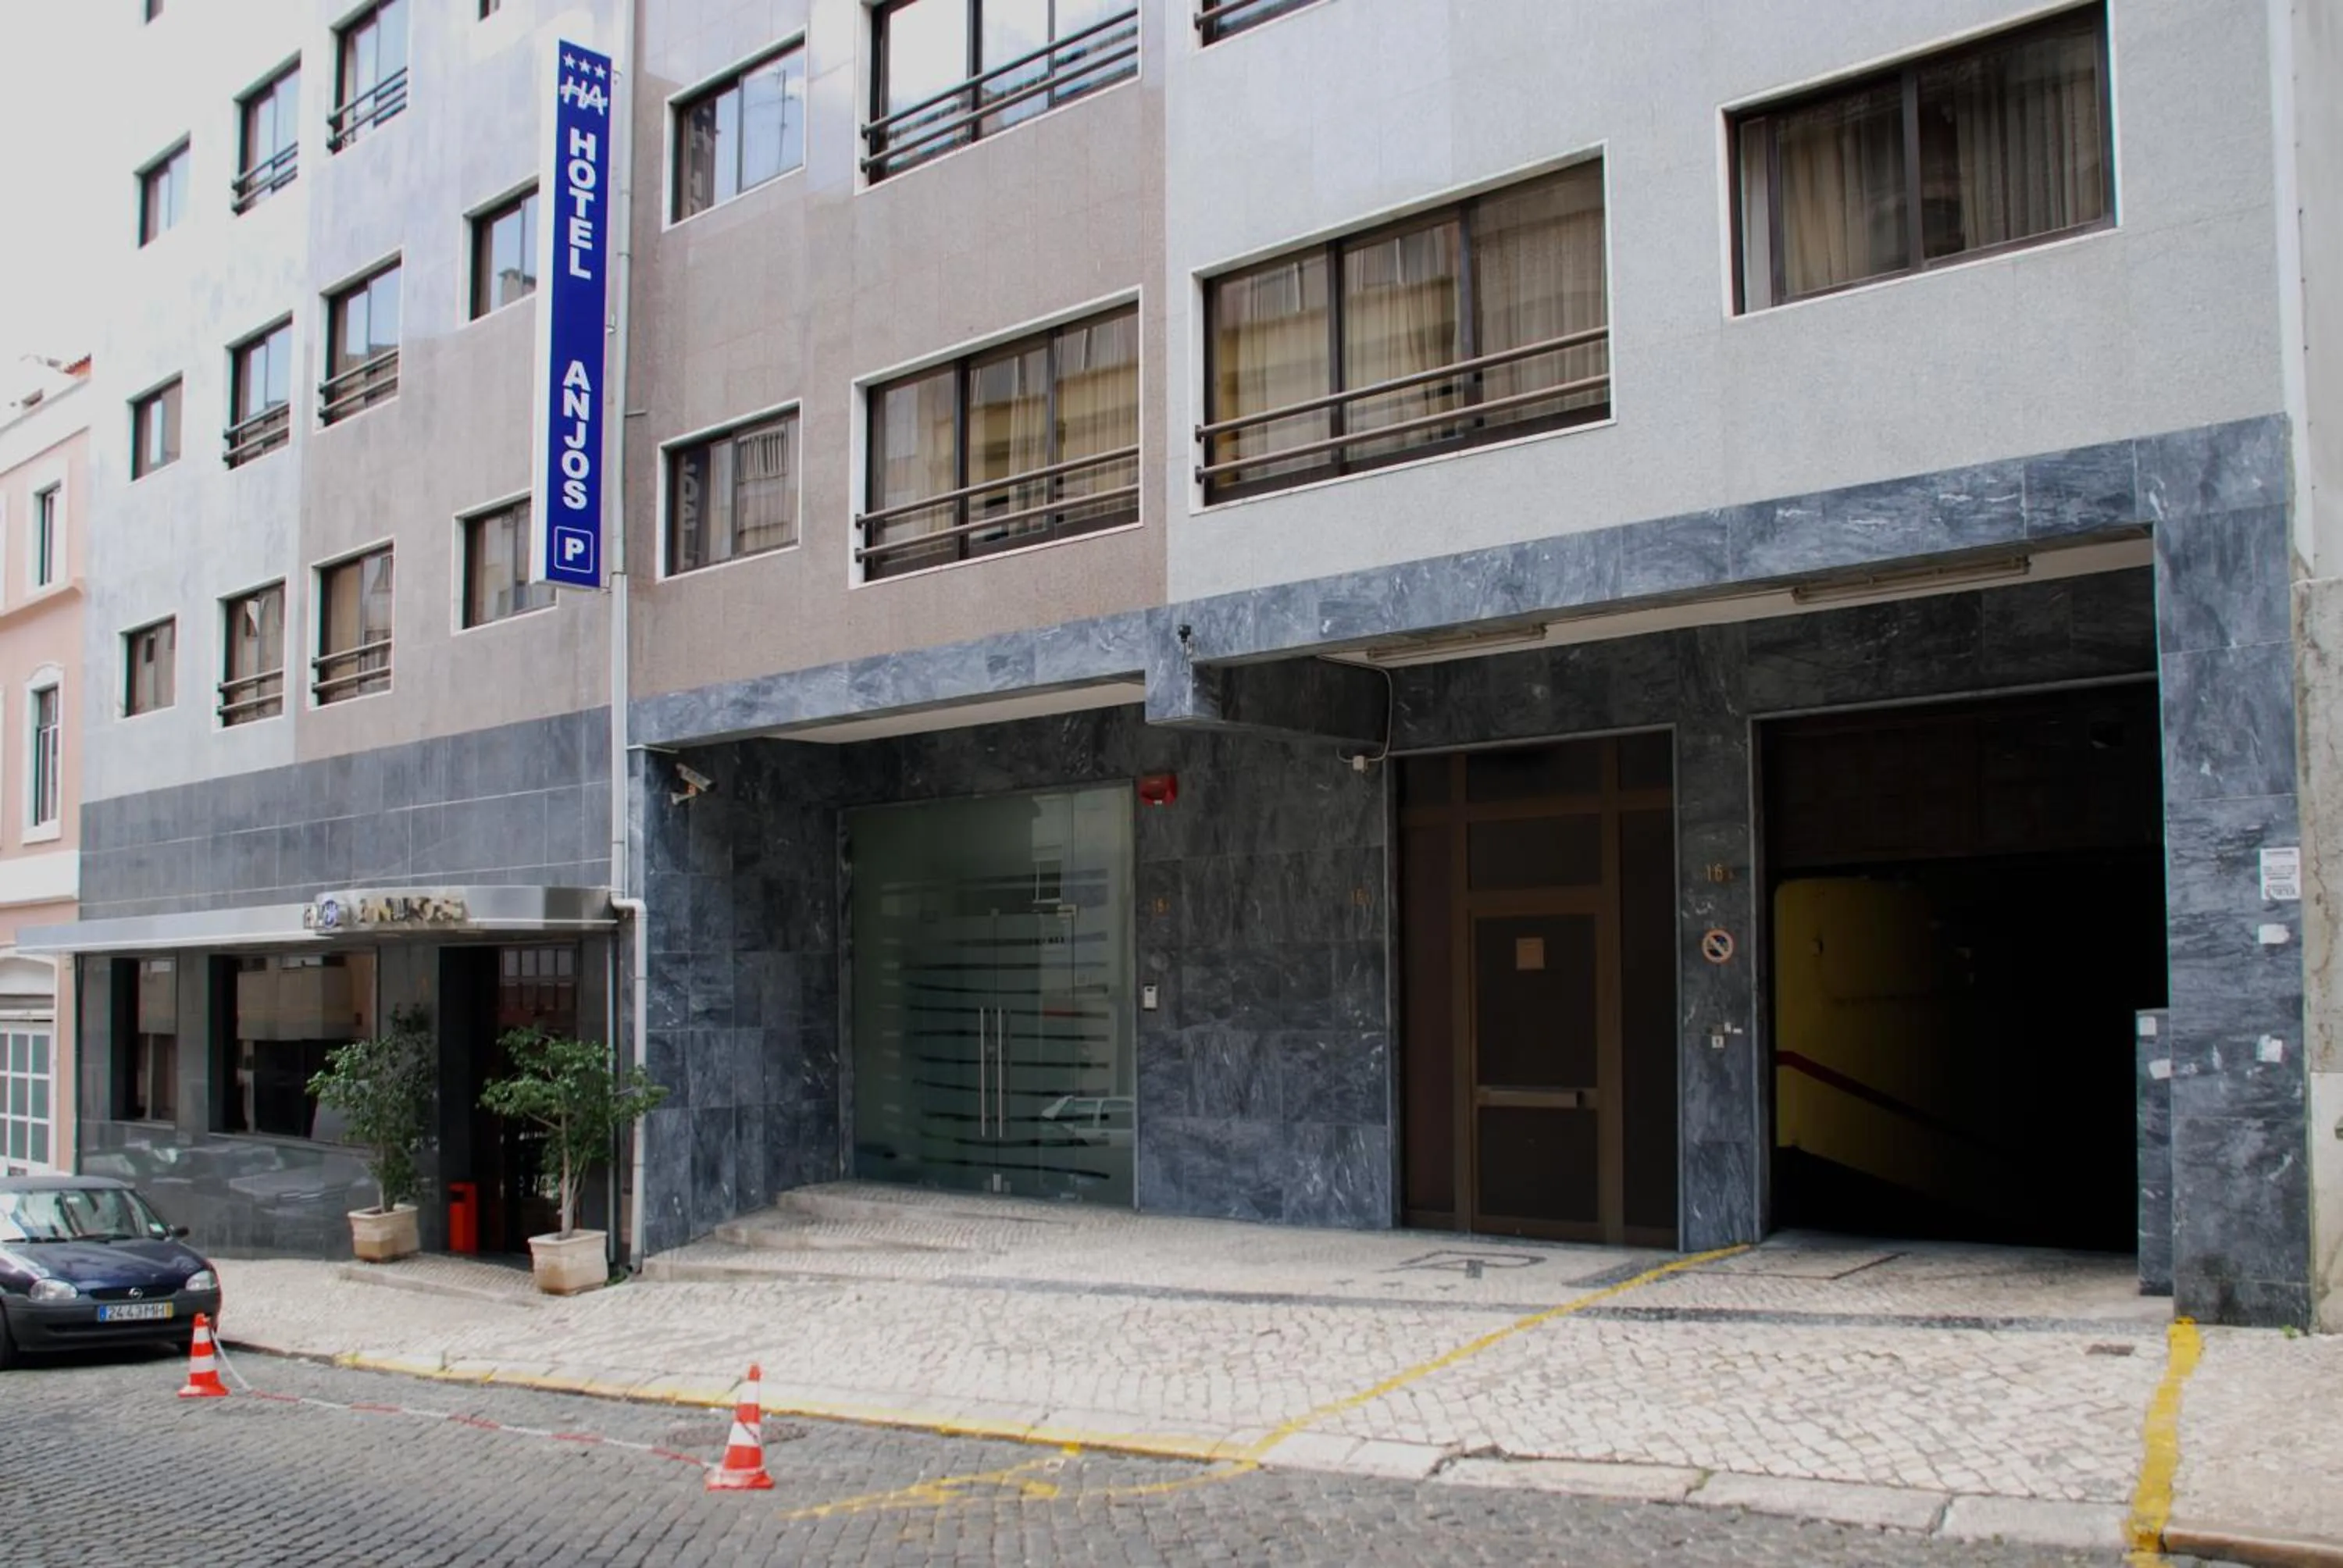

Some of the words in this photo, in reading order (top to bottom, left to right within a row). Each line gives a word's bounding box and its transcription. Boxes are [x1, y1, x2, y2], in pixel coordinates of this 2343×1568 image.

[569, 127, 596, 280] HOTEL
[562, 360, 591, 509] ANJOS
[565, 537, 584, 561] P
